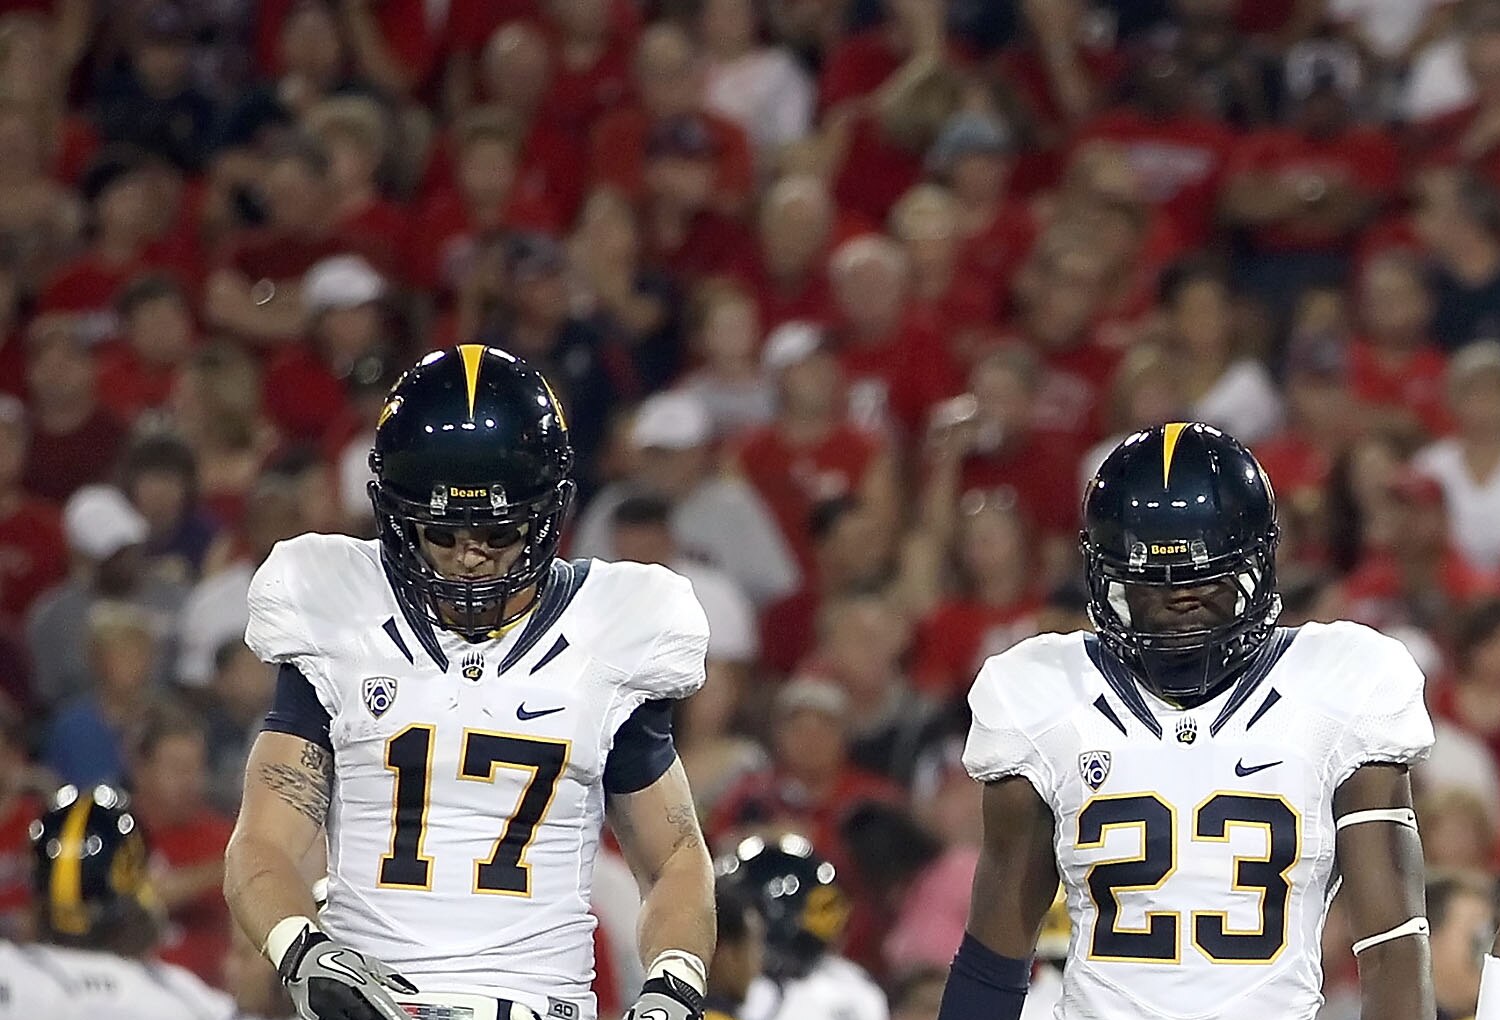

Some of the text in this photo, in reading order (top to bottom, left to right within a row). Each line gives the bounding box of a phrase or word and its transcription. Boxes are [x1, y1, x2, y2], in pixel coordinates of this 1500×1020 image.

[450, 487, 487, 498] Bears
[1151, 545, 1187, 554] Bears
[364, 678, 397, 703] PAC
[371, 694, 389, 710] 10
[1080, 751, 1110, 777] PAC
[1088, 767, 1106, 784] 10
[376, 723, 572, 898] 17
[1074, 790, 1302, 964] 23
[553, 1003, 573, 1017] 40
